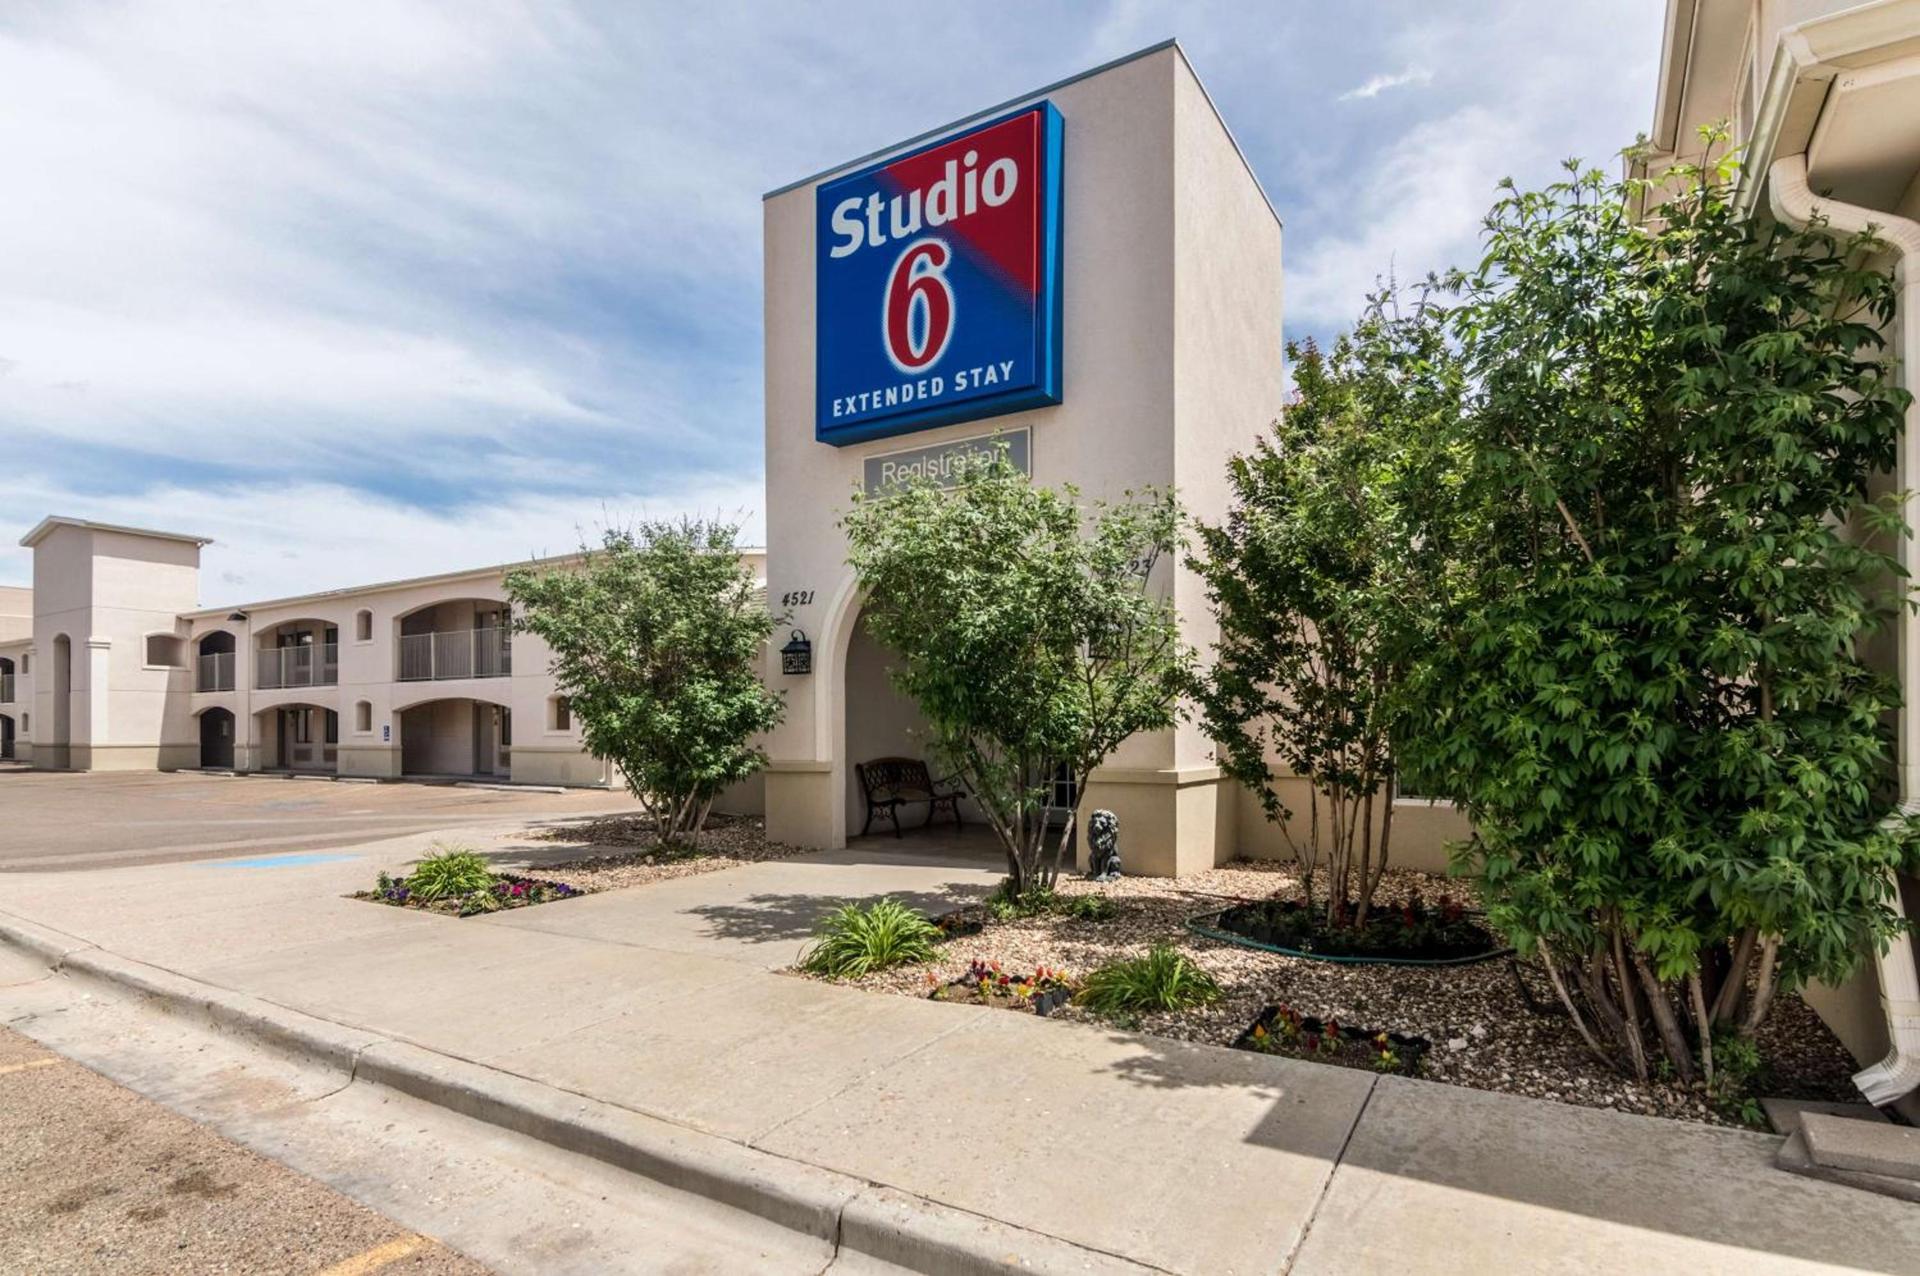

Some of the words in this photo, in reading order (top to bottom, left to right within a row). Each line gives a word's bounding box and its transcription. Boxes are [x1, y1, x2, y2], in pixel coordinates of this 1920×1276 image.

[830, 149, 1018, 258] Studio
[883, 238, 955, 374] 6
[832, 376, 945, 417] EXTENDED
[955, 360, 1015, 392] STAY
[882, 446, 1000, 485] Registrao
[782, 590, 815, 607] 4521
